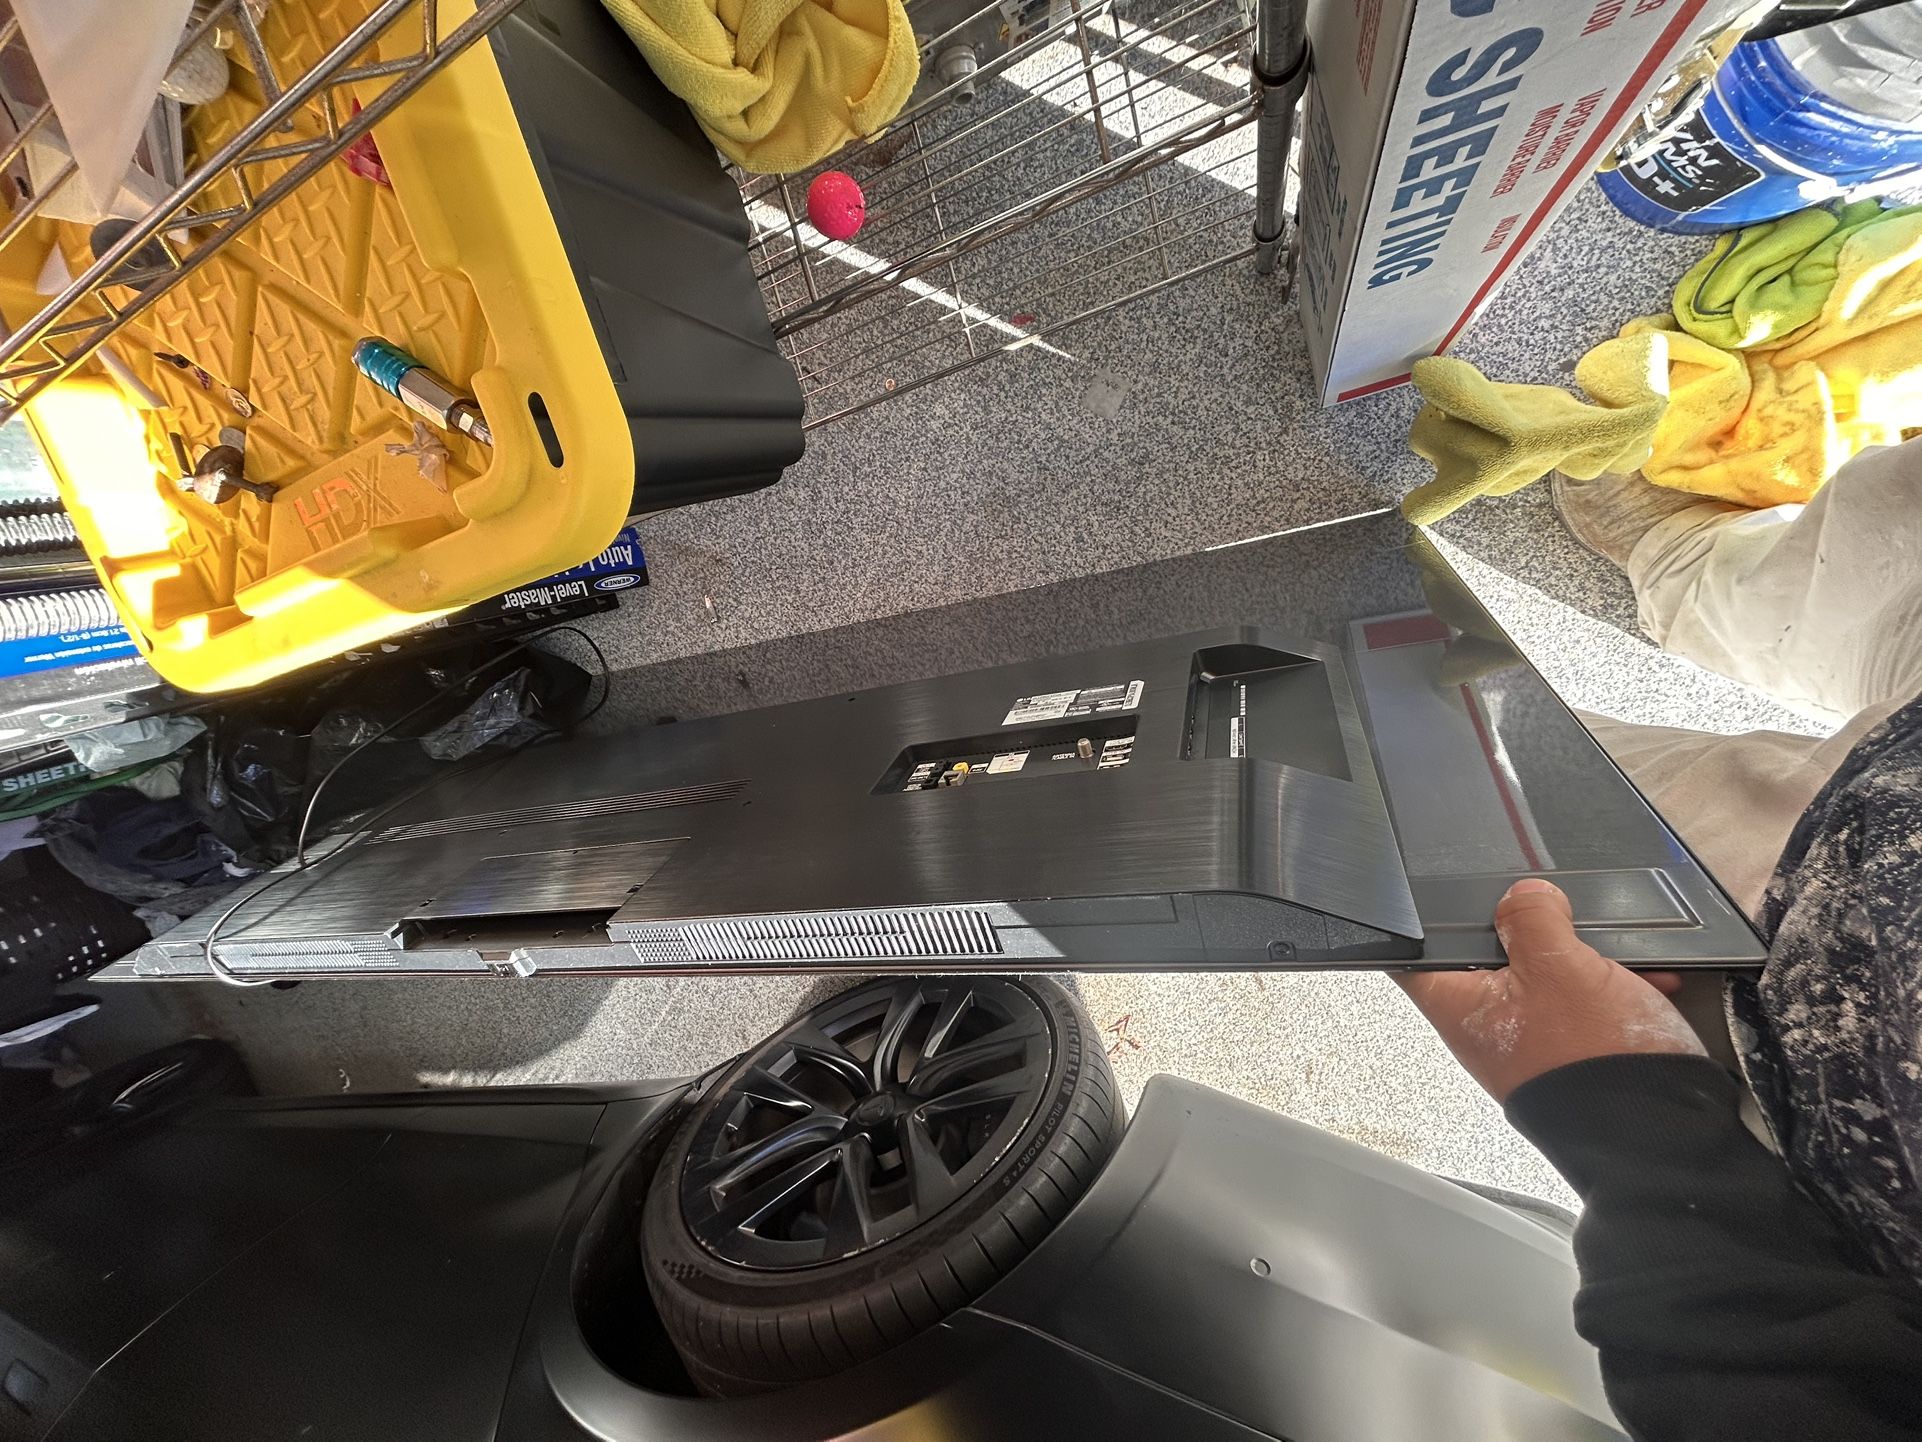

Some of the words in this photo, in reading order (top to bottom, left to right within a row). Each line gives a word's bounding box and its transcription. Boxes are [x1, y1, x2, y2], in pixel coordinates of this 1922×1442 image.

[1511, 103, 1565, 162] MOISTURE
[1559, 88, 1607, 133] VAPOR
[1367, 27, 1544, 289] SHEETING
[1532, 129, 1581, 174] BARRIER
[1490, 157, 1532, 198] BARRIER
[294, 454, 401, 553] HDX
[599, 545, 633, 567] Auto
[604, 577, 631, 586] WERNER
[1061, 1015, 1080, 1096] MICHELIN
[1045, 1103, 1064, 1133] PILOT
[1017, 1134, 1046, 1171] SPORT
